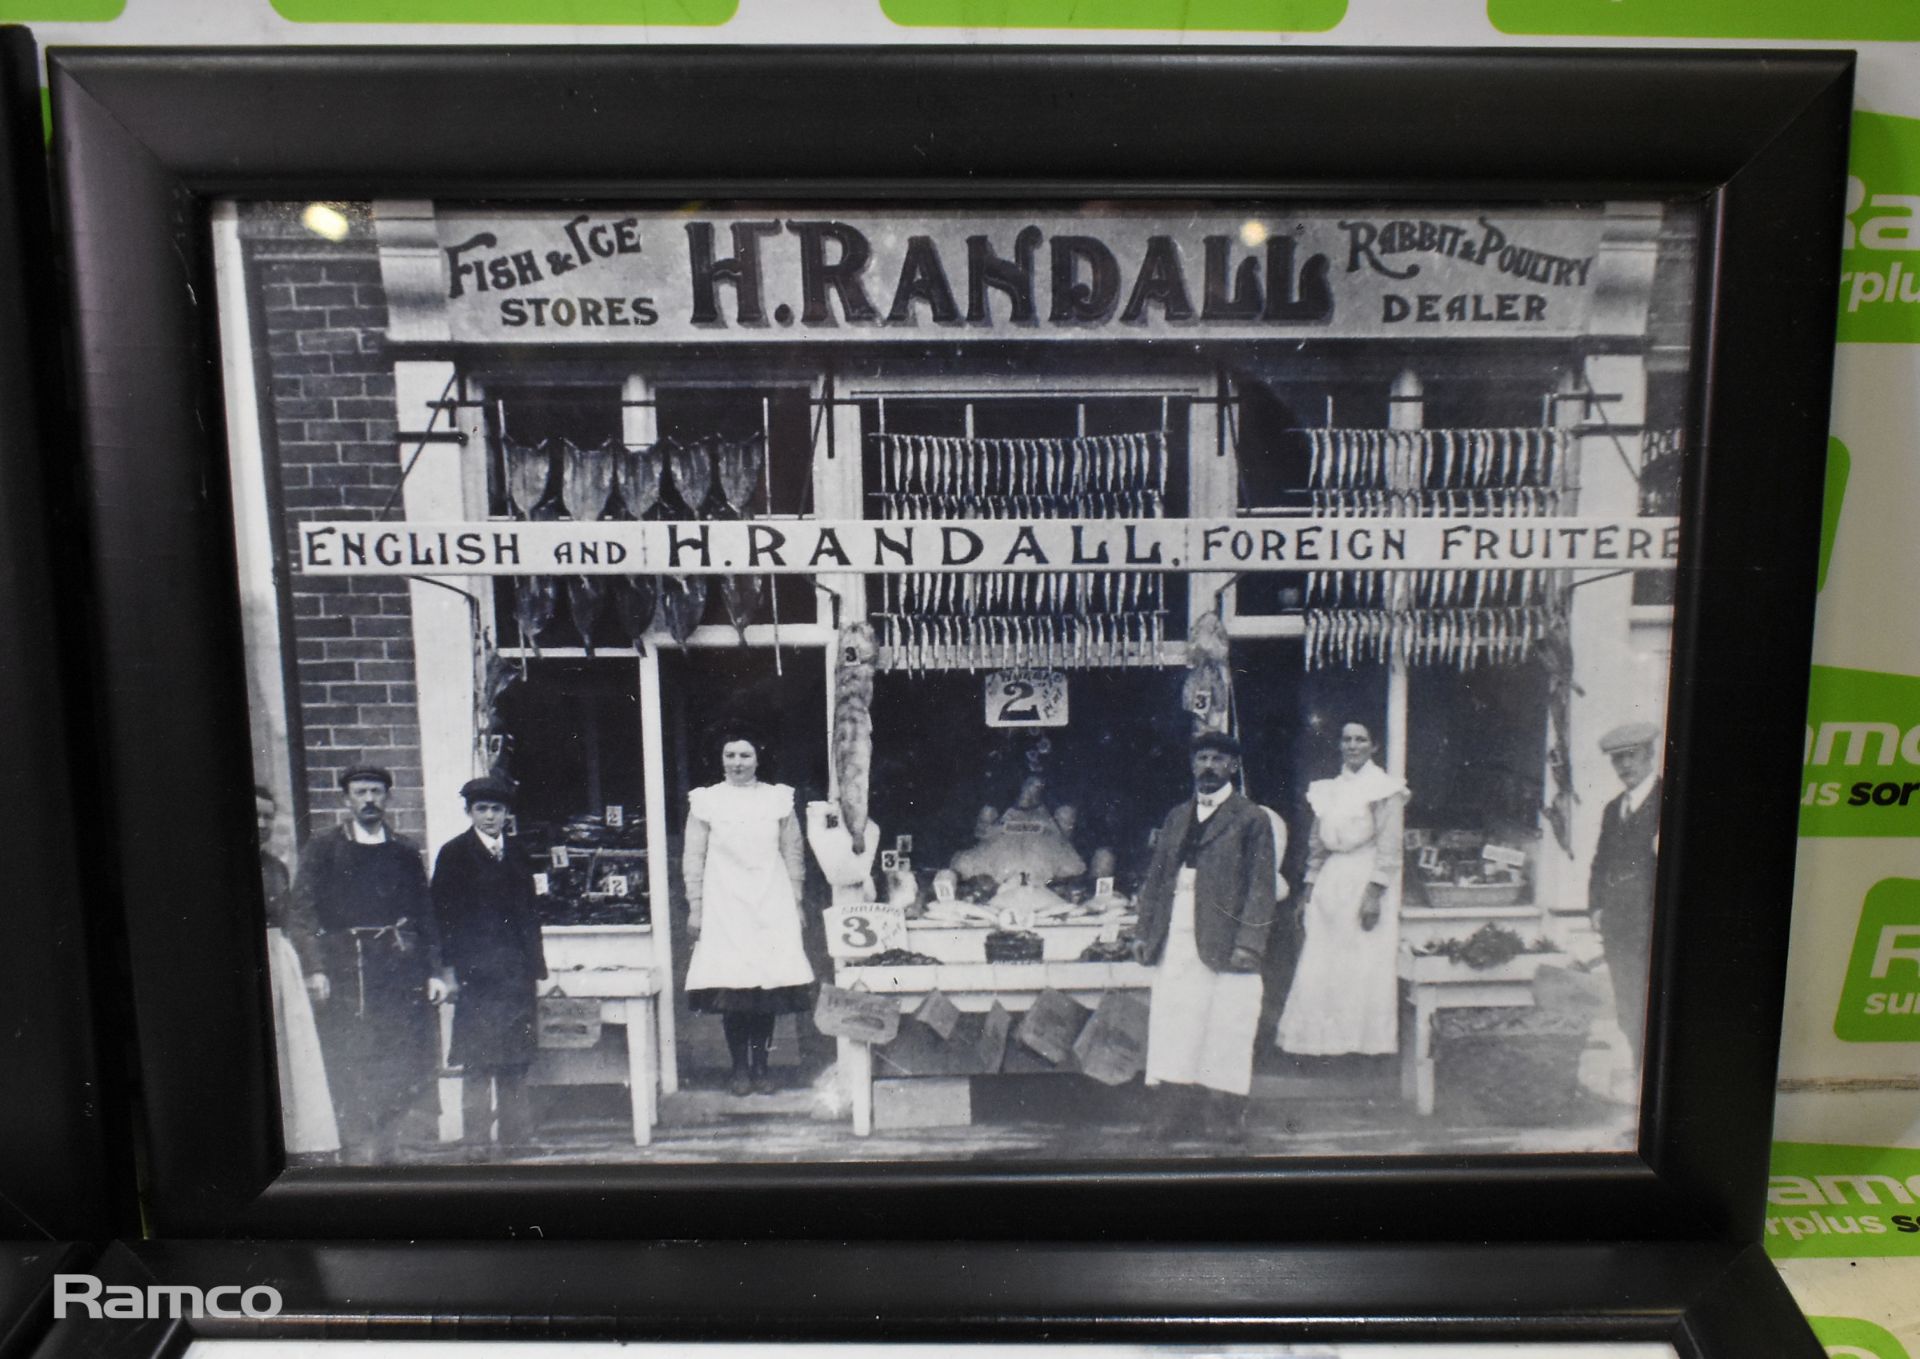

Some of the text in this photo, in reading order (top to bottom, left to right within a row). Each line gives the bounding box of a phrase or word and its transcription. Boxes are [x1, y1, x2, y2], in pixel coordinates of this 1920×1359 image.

[444, 214, 642, 299] FISH & ICE
[500, 297, 659, 327] STORES
[1382, 293, 1548, 323] DEALER
[305, 526, 521, 566] ENGLISH
[553, 541, 627, 565] AND
[1202, 525, 1406, 561] FOREIGN
[998, 681, 1041, 721] 2
[1195, 694, 1207, 710] 3
[883, 853, 896, 868] 3
[841, 915, 878, 948] 3
